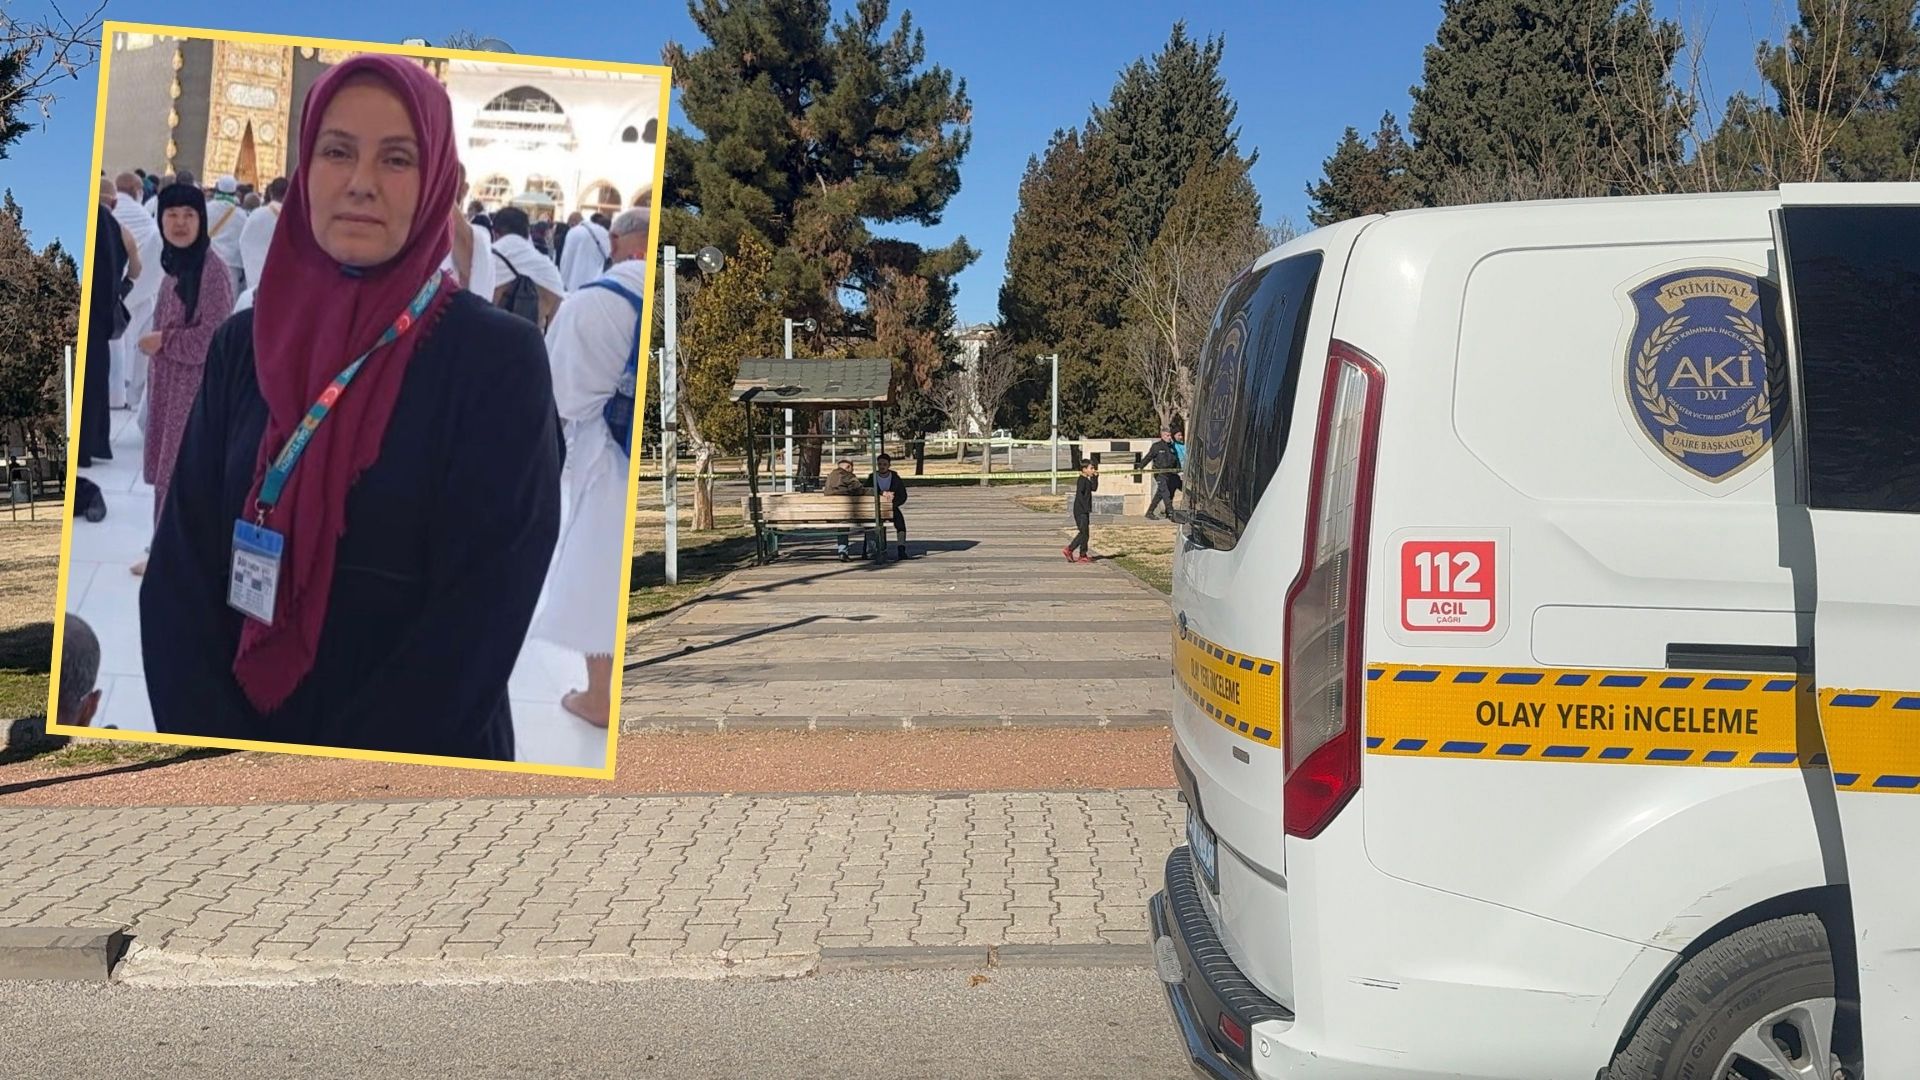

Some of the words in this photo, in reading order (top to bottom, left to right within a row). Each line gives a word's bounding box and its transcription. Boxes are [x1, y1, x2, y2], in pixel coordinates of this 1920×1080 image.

[1665, 280, 1749, 299] KRİMİNAL
[1668, 350, 1753, 387] AKİ
[1696, 390, 1728, 401] DVI
[1667, 396, 1693, 417] DISASTER
[1692, 411, 1714, 421] VICTIM
[1714, 395, 1757, 421] IDENTIFICATION
[1701, 434, 1756, 453] BAŞKANLIĞI
[1414, 551, 1481, 593] 112
[1436, 615, 1462, 625] ÇAĞRI
[1476, 700, 1547, 728] OLAY
